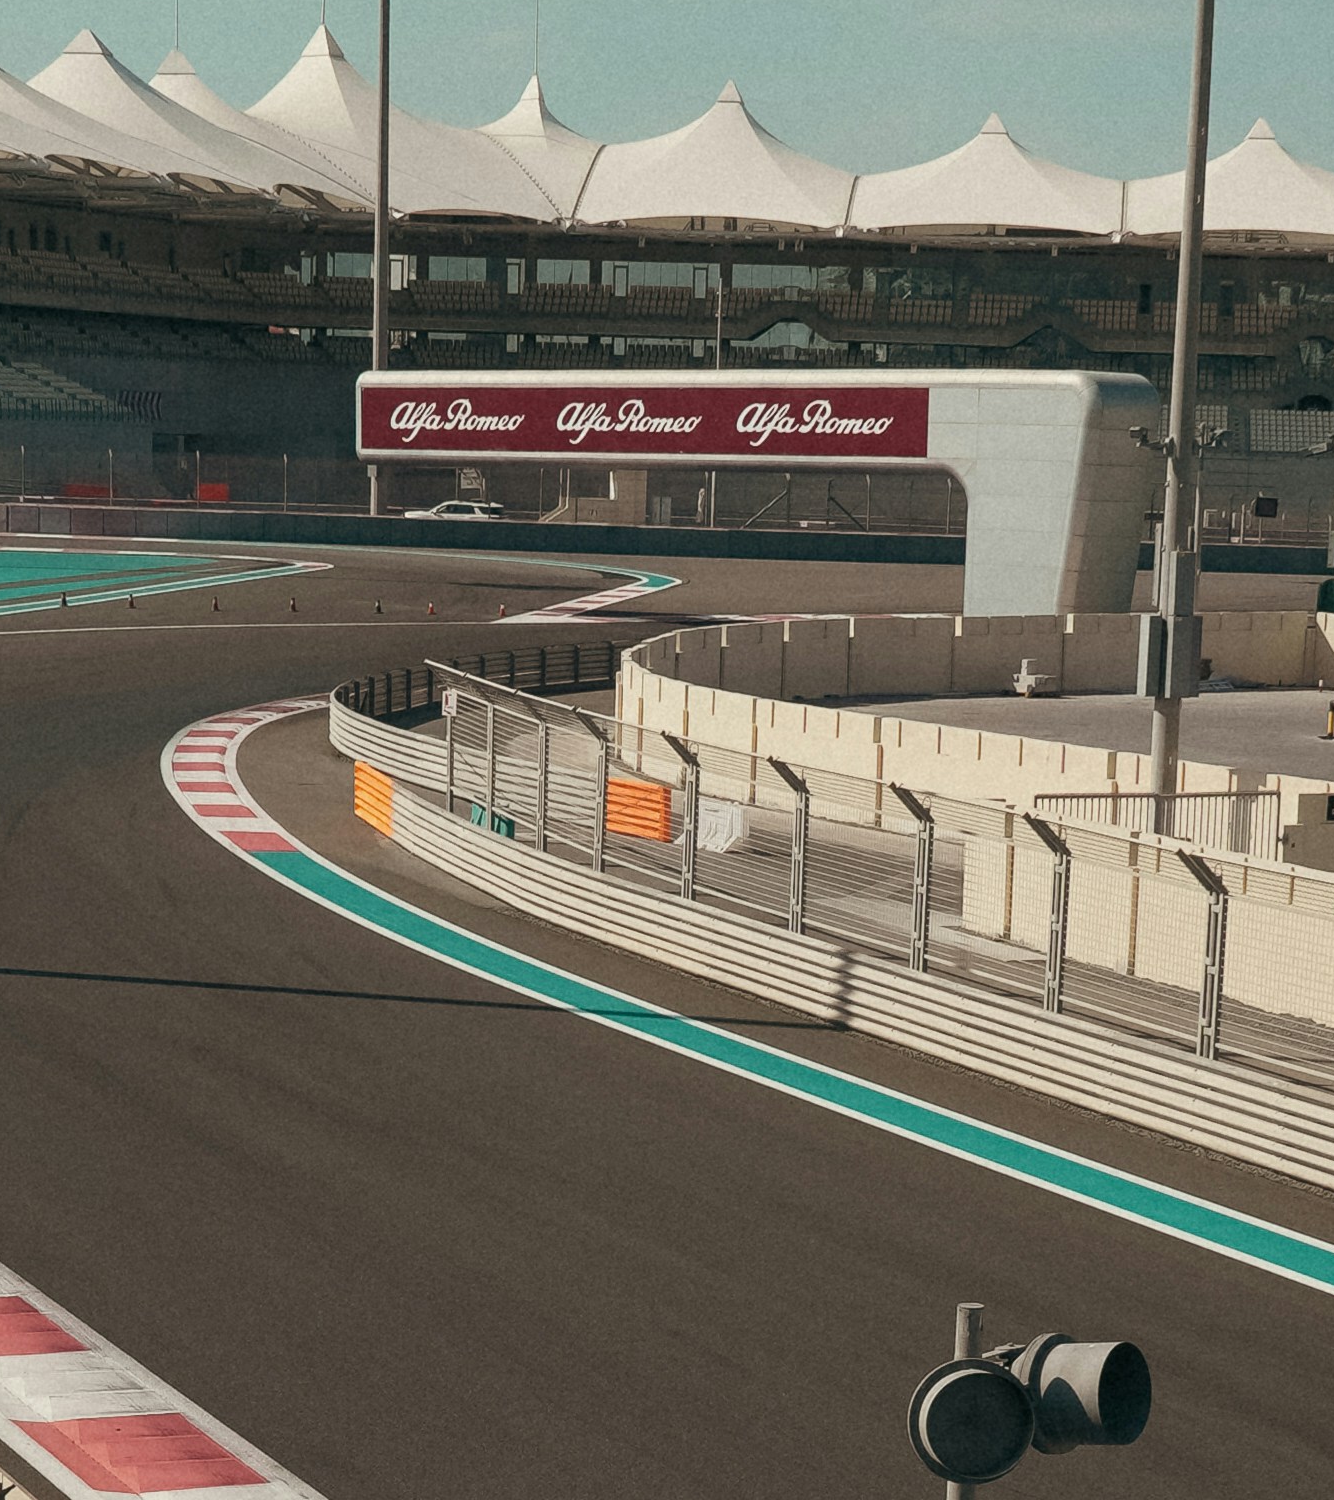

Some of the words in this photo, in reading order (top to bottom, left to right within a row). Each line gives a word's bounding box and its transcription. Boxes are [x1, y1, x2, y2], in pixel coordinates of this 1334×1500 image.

[390, 401, 444, 443] Alfa
[443, 398, 525, 431] Romeo
[556, 402, 615, 445] Alfa
[614, 399, 703, 433] Romeo
[736, 403, 799, 447] Alfa
[798, 399, 894, 435] Romeo
